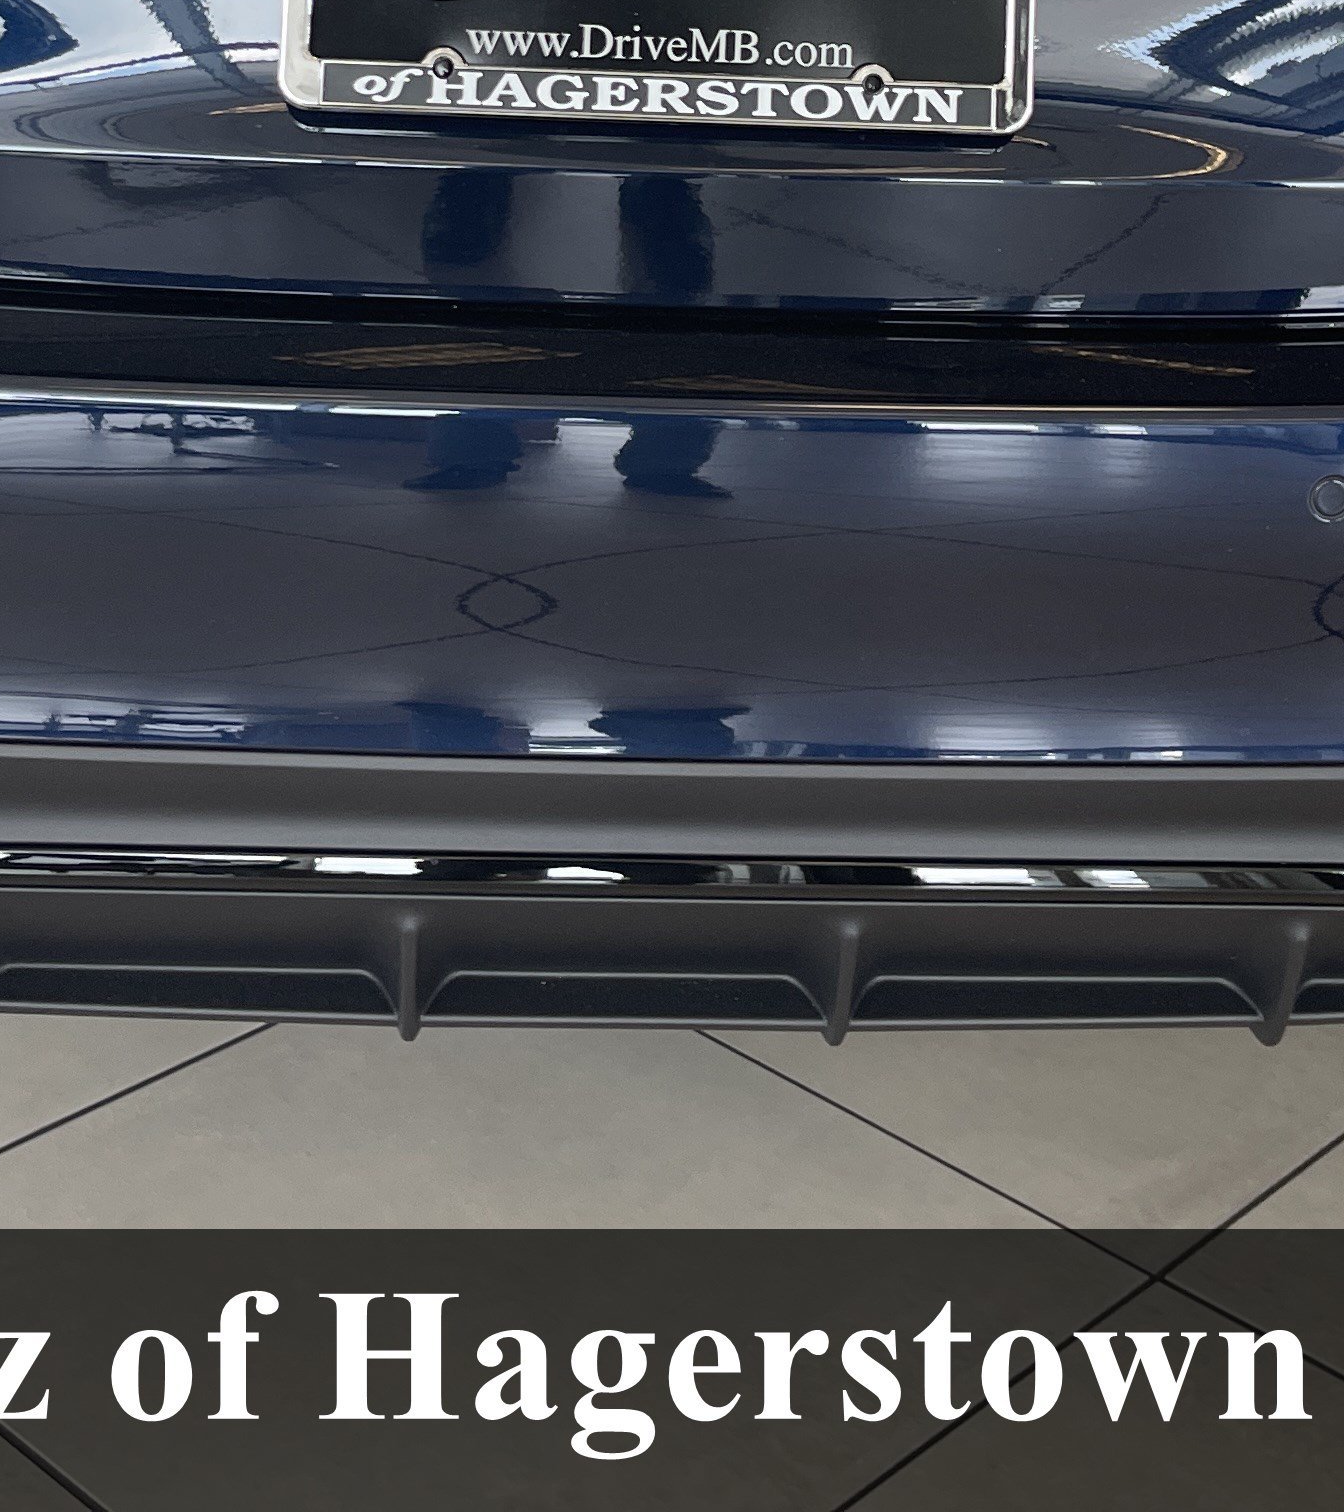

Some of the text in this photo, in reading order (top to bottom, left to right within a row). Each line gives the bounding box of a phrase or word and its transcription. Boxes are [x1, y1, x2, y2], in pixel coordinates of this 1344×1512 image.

[465, 23, 855, 69] www.DriveMB.com
[353, 69, 964, 125] of HAGERSTOWN
